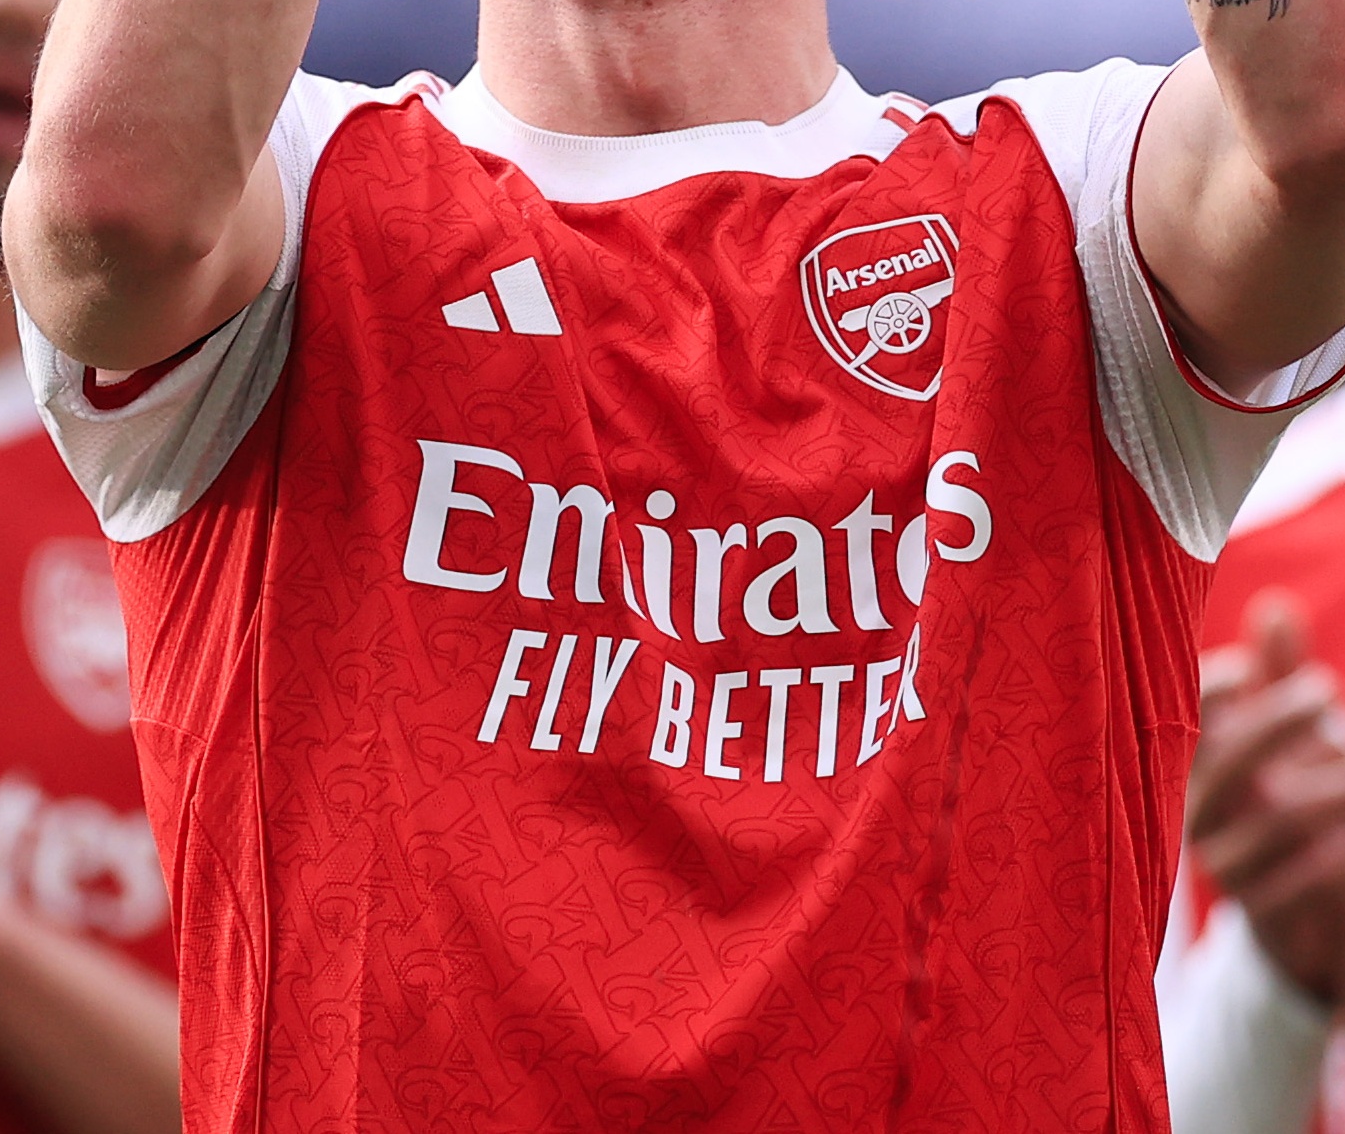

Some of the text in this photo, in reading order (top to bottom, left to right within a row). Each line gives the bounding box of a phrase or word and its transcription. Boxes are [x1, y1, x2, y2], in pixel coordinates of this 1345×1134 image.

[826, 239, 941, 298] Arsenal
[477, 622, 926, 783] FLY BETTER
